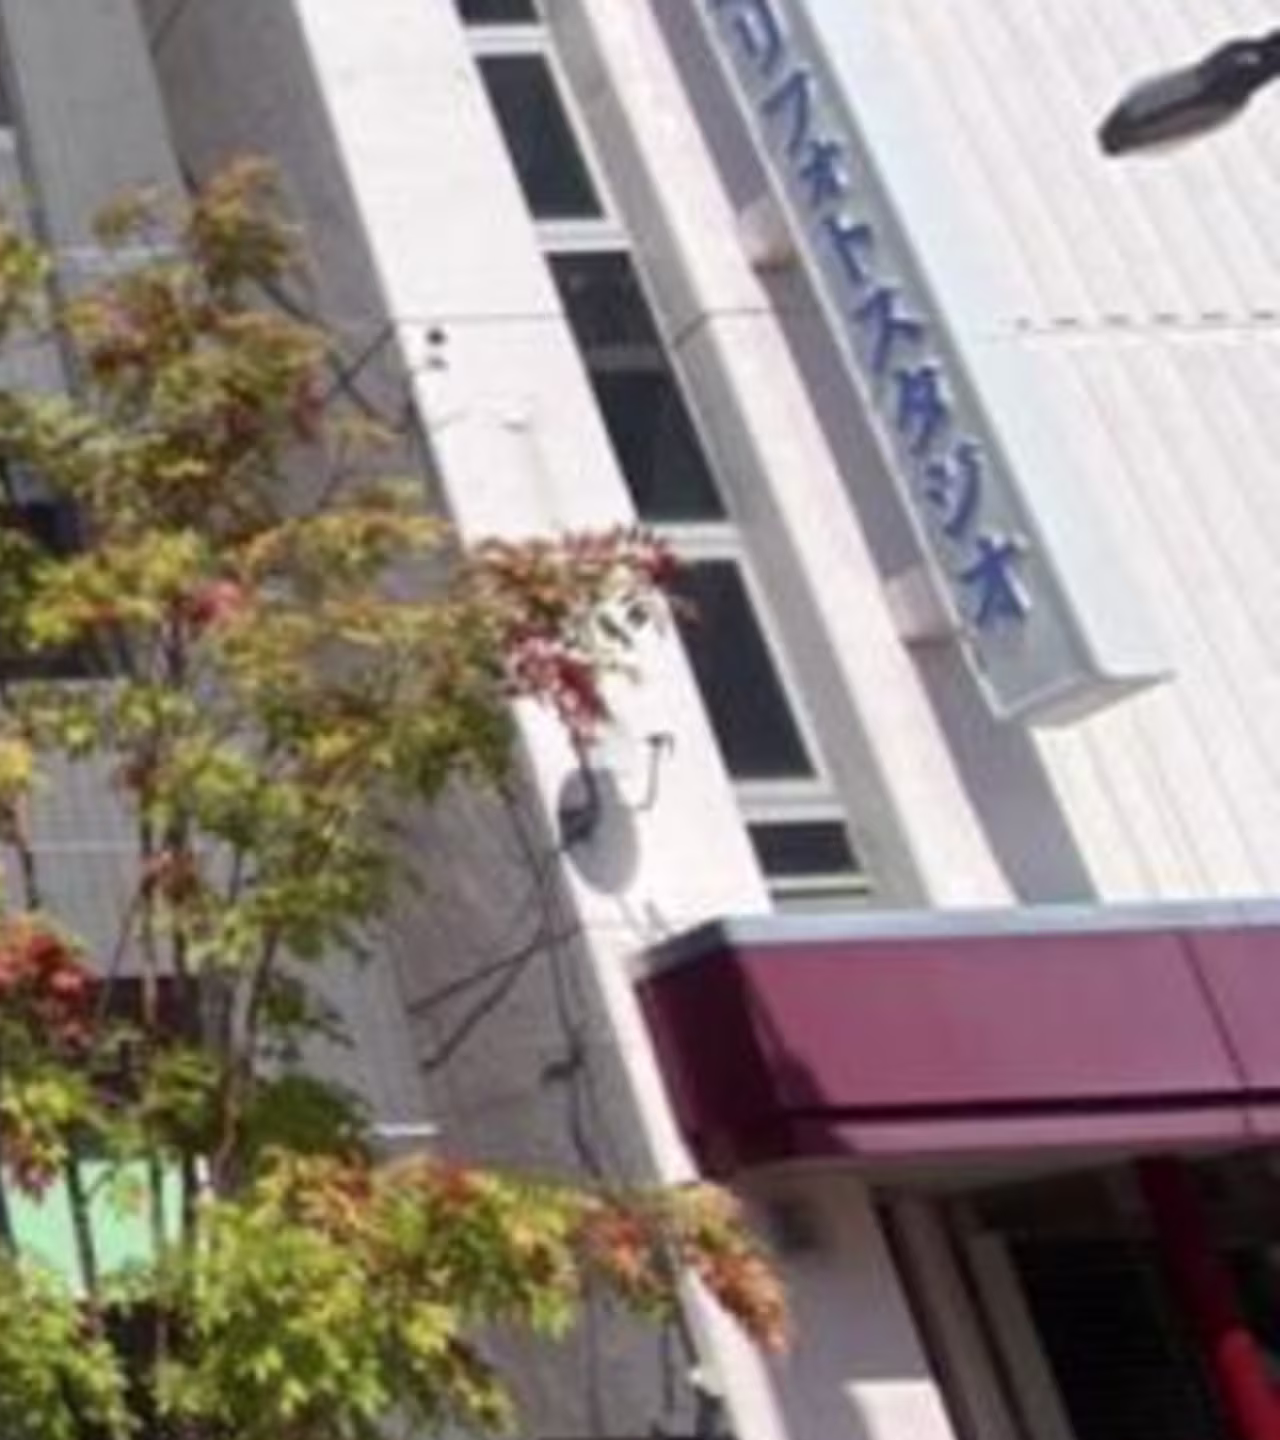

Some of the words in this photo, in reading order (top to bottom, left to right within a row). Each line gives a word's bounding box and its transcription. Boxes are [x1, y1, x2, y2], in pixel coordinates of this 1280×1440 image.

[704, 0, 1030, 628] リフォトスタジオ
